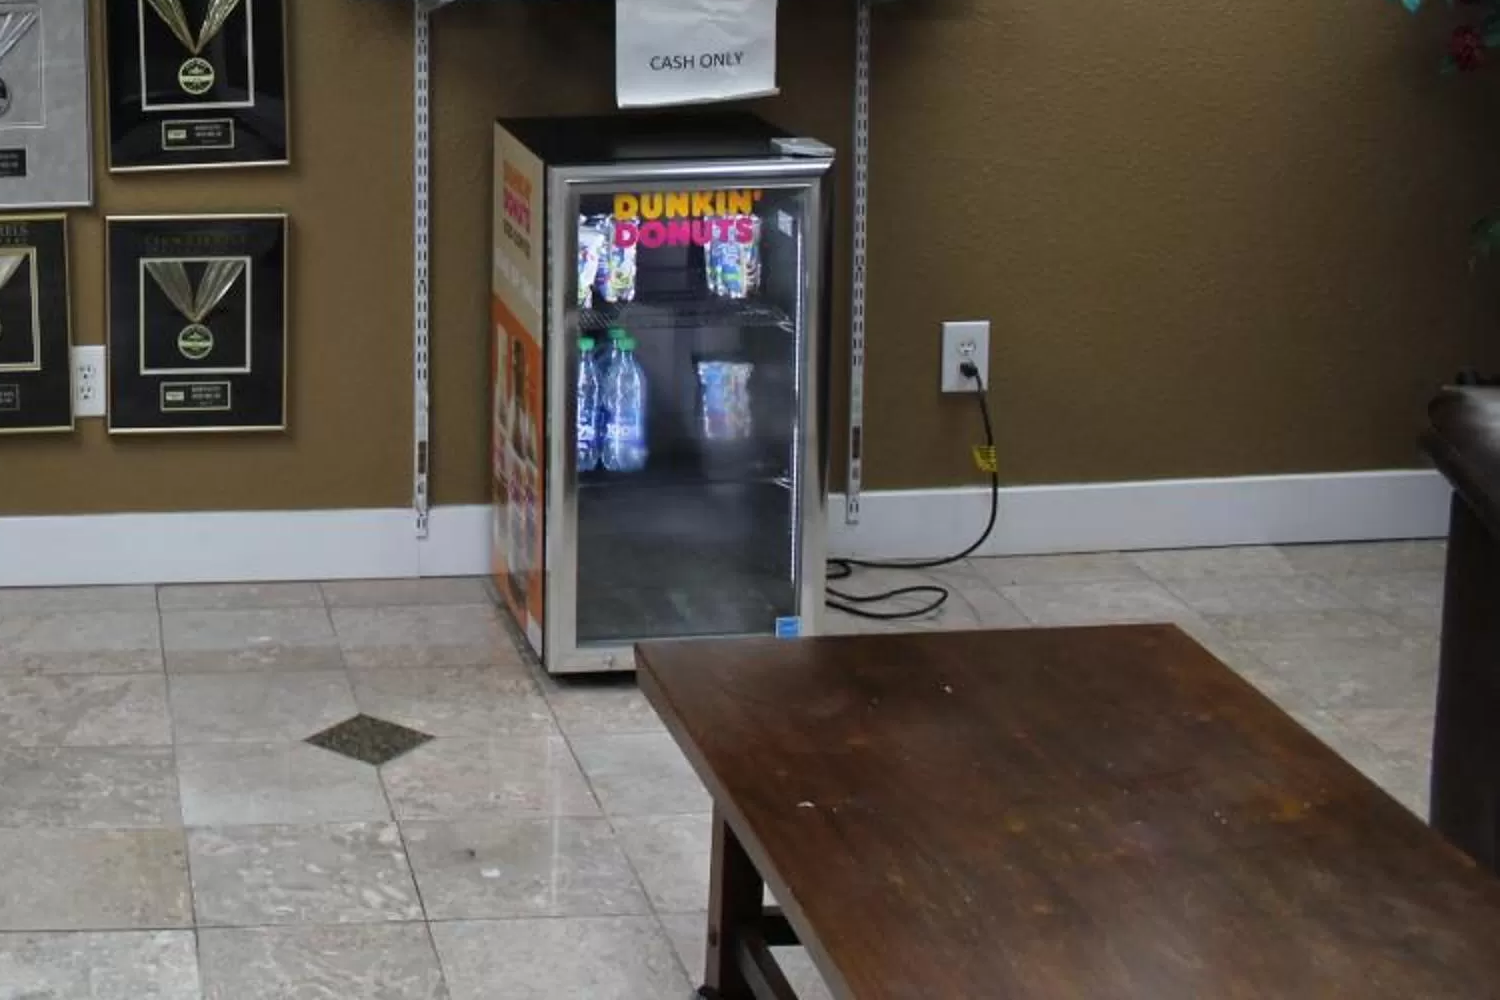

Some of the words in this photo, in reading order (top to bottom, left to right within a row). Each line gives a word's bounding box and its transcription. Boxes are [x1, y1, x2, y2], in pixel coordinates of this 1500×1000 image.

[649, 55, 695, 72] CASH
[699, 51, 745, 69] ONLY
[612, 190, 763, 221] DUNKIN'
[613, 218, 754, 248] DONUTS
